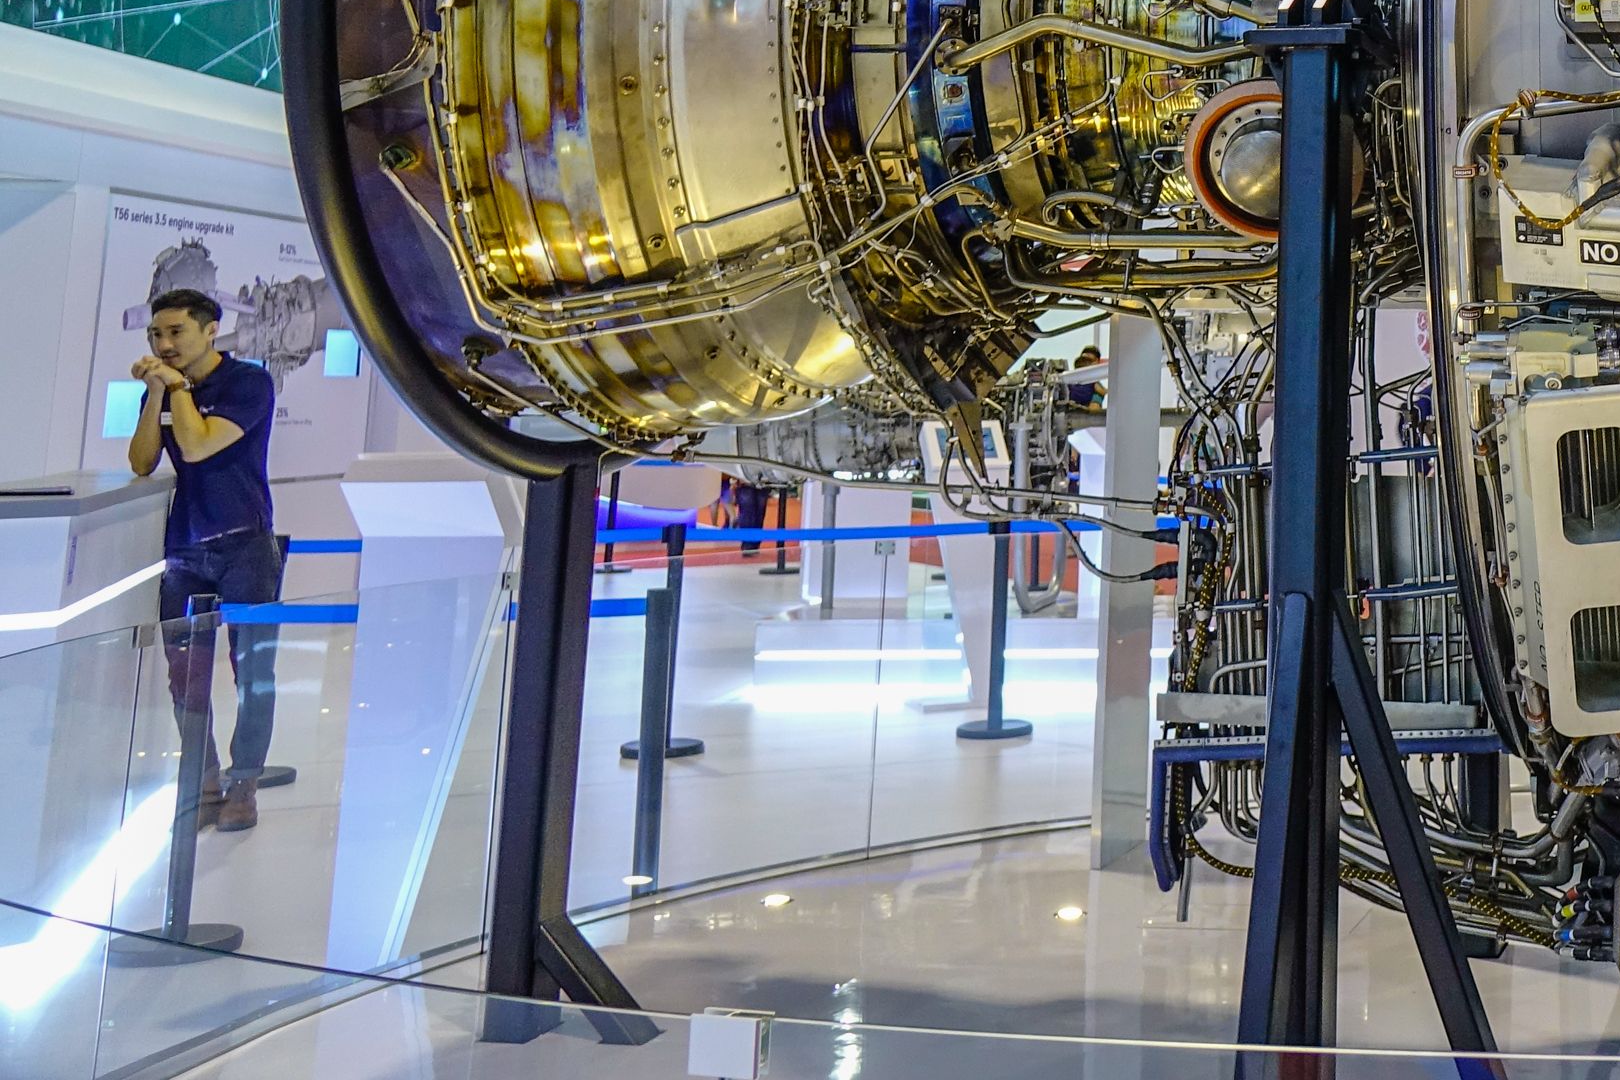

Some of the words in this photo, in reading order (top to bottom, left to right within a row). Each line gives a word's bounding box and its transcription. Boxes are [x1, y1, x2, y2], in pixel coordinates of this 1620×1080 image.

[114, 206, 129, 221] T56
[131, 211, 153, 224] series
[155, 212, 167, 226] 3.5
[168, 217, 194, 232] engine
[195, 221, 224, 235] upgrade
[225, 223, 235, 236] kit
[1583, 242, 1619, 263] NO
